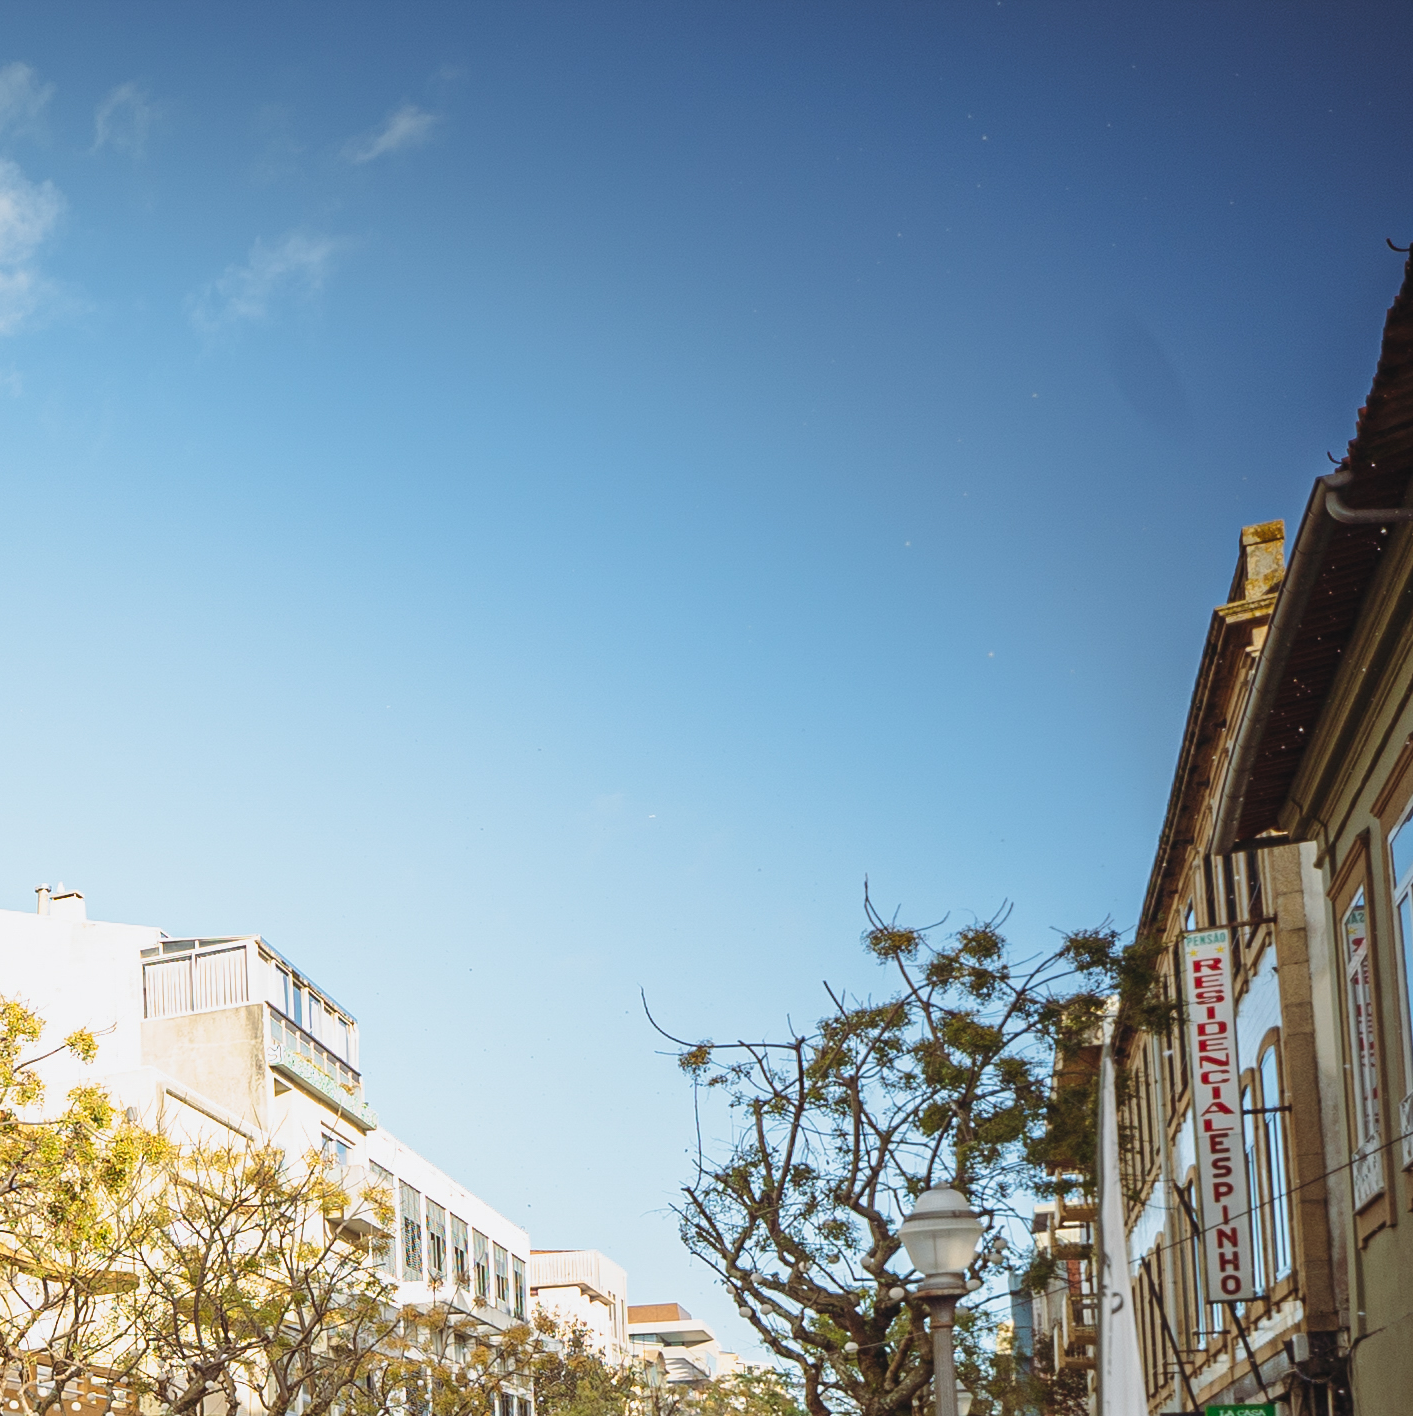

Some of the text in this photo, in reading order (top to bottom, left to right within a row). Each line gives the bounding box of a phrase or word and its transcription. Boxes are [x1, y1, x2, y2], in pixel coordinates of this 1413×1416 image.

[1186, 931, 1227, 948] PENSÃO
[1191, 957, 1242, 1296] RESIDENCIAL ESPINHO
[1237, 1409, 1267, 1416] CASA
